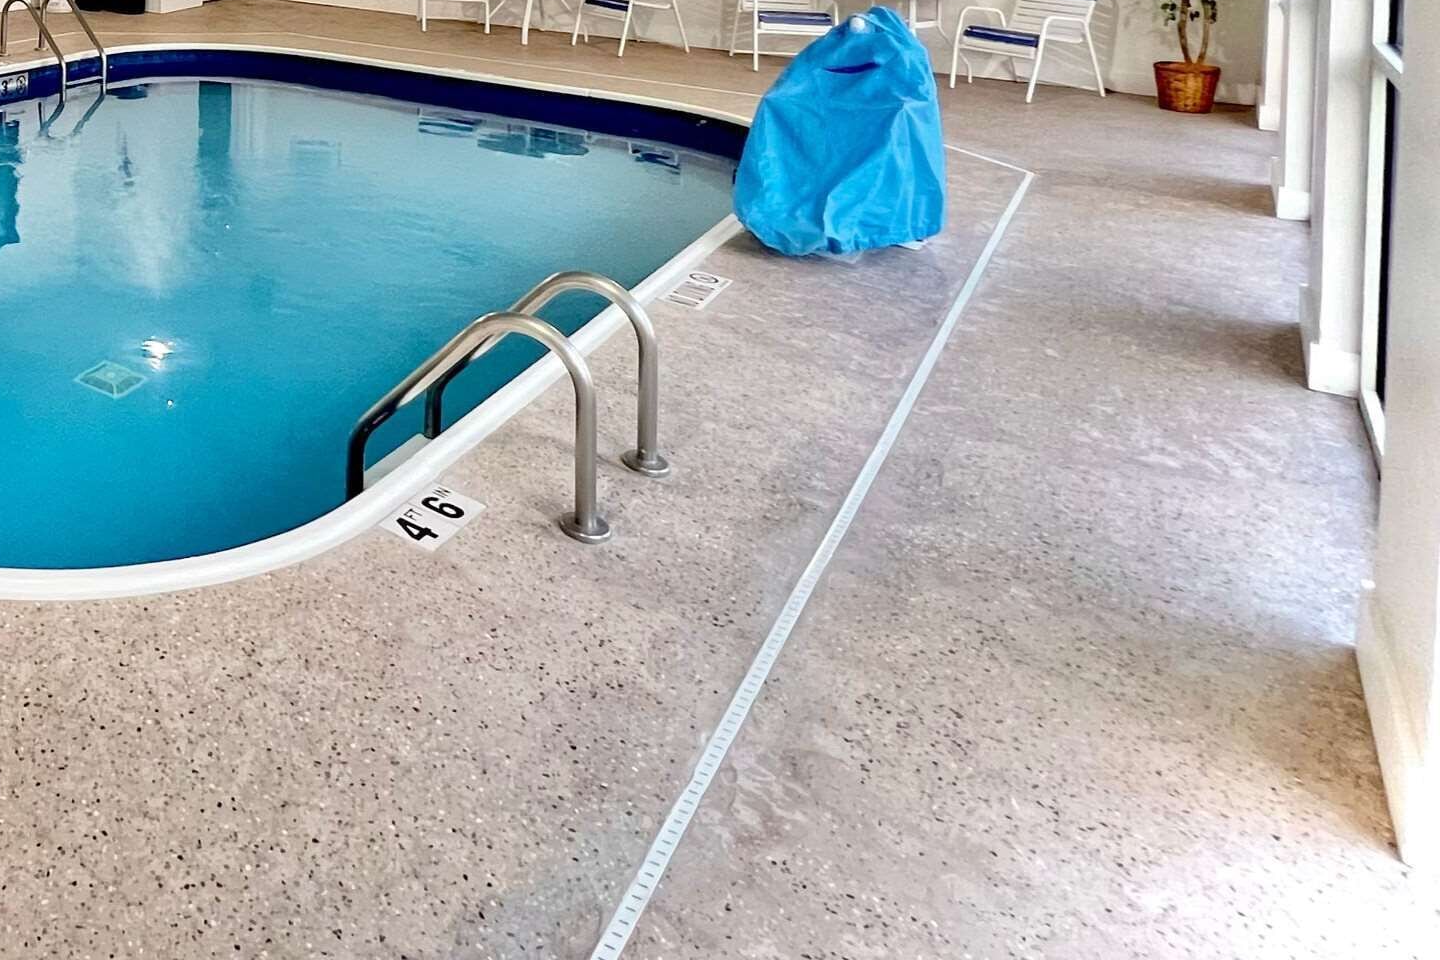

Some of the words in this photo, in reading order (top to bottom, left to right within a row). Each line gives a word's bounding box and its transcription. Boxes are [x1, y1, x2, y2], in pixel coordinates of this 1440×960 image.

[431, 486, 452, 498] IN
[403, 508, 423, 521] FT
[421, 496, 465, 519] 6
[396, 517, 439, 541] 4
